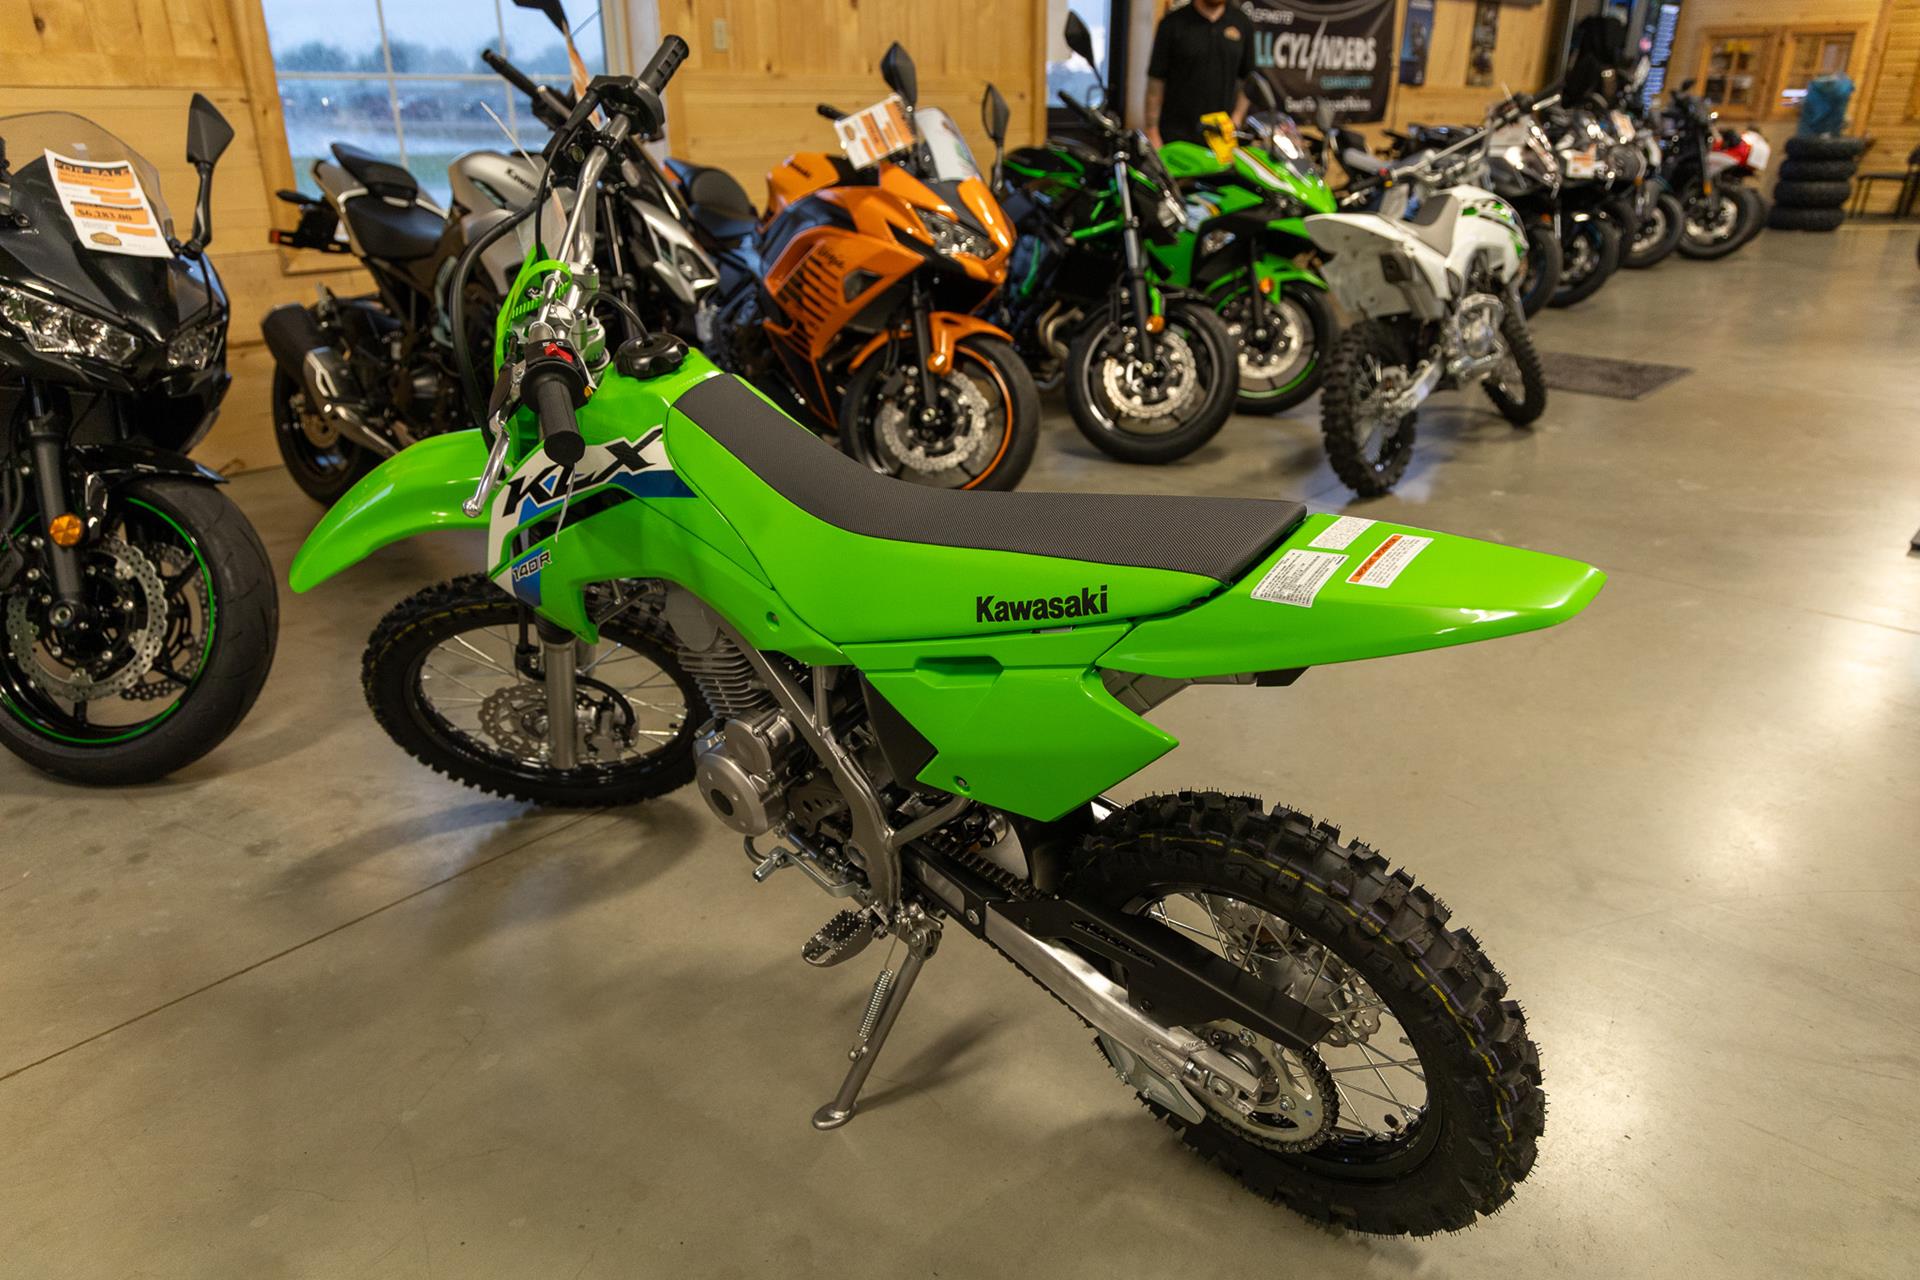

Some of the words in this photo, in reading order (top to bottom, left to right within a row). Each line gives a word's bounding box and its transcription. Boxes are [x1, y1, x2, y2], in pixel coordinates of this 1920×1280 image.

[55, 160, 84, 174] FOR
[90, 166, 130, 177] SALE
[502, 426, 664, 518] KLX
[511, 550, 552, 582] 140R
[976, 584, 1108, 623] Kawasaki
